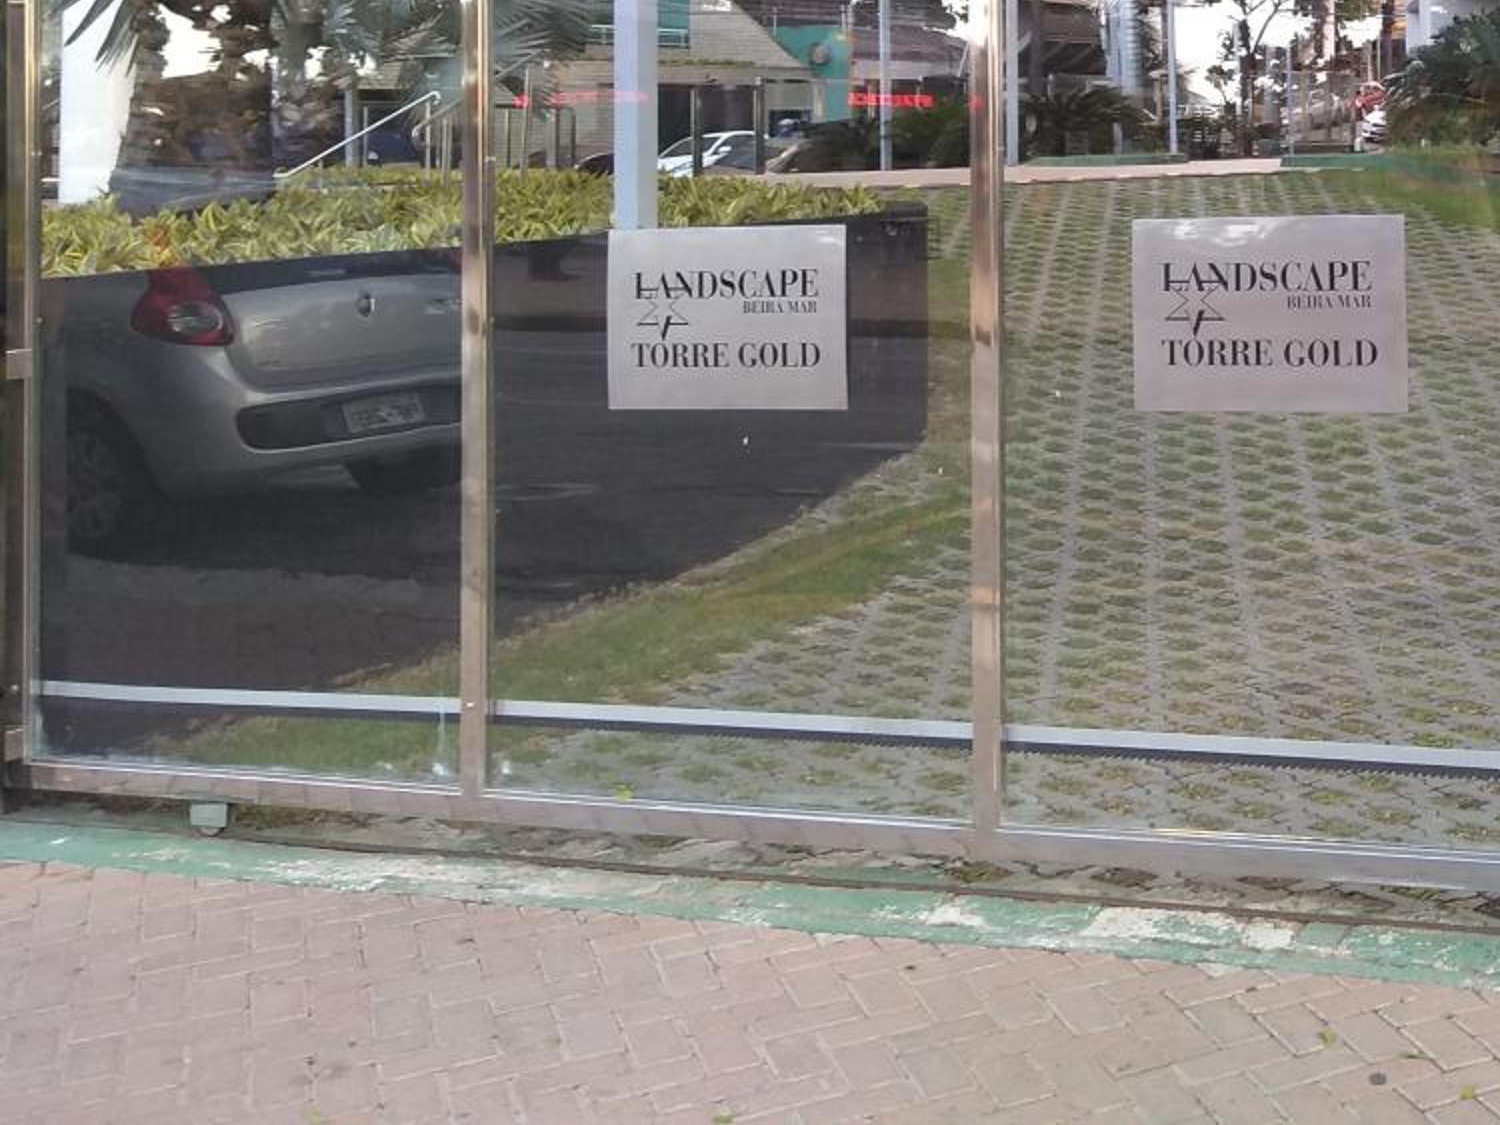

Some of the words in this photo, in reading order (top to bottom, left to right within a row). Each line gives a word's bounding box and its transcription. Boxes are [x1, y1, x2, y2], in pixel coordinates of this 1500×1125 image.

[634, 268, 820, 300] LANDSCAPE
[1161, 259, 1373, 292] LANDSCAPE
[742, 300, 783, 314] BEIRA
[789, 300, 818, 314] MAR
[1286, 294, 1333, 309] BEIRA
[1338, 294, 1372, 309] MAR
[630, 341, 730, 369] TORRE
[738, 341, 821, 369] GOLD
[1161, 338, 1273, 367] TORRE
[1283, 338, 1378, 367] GOLD
